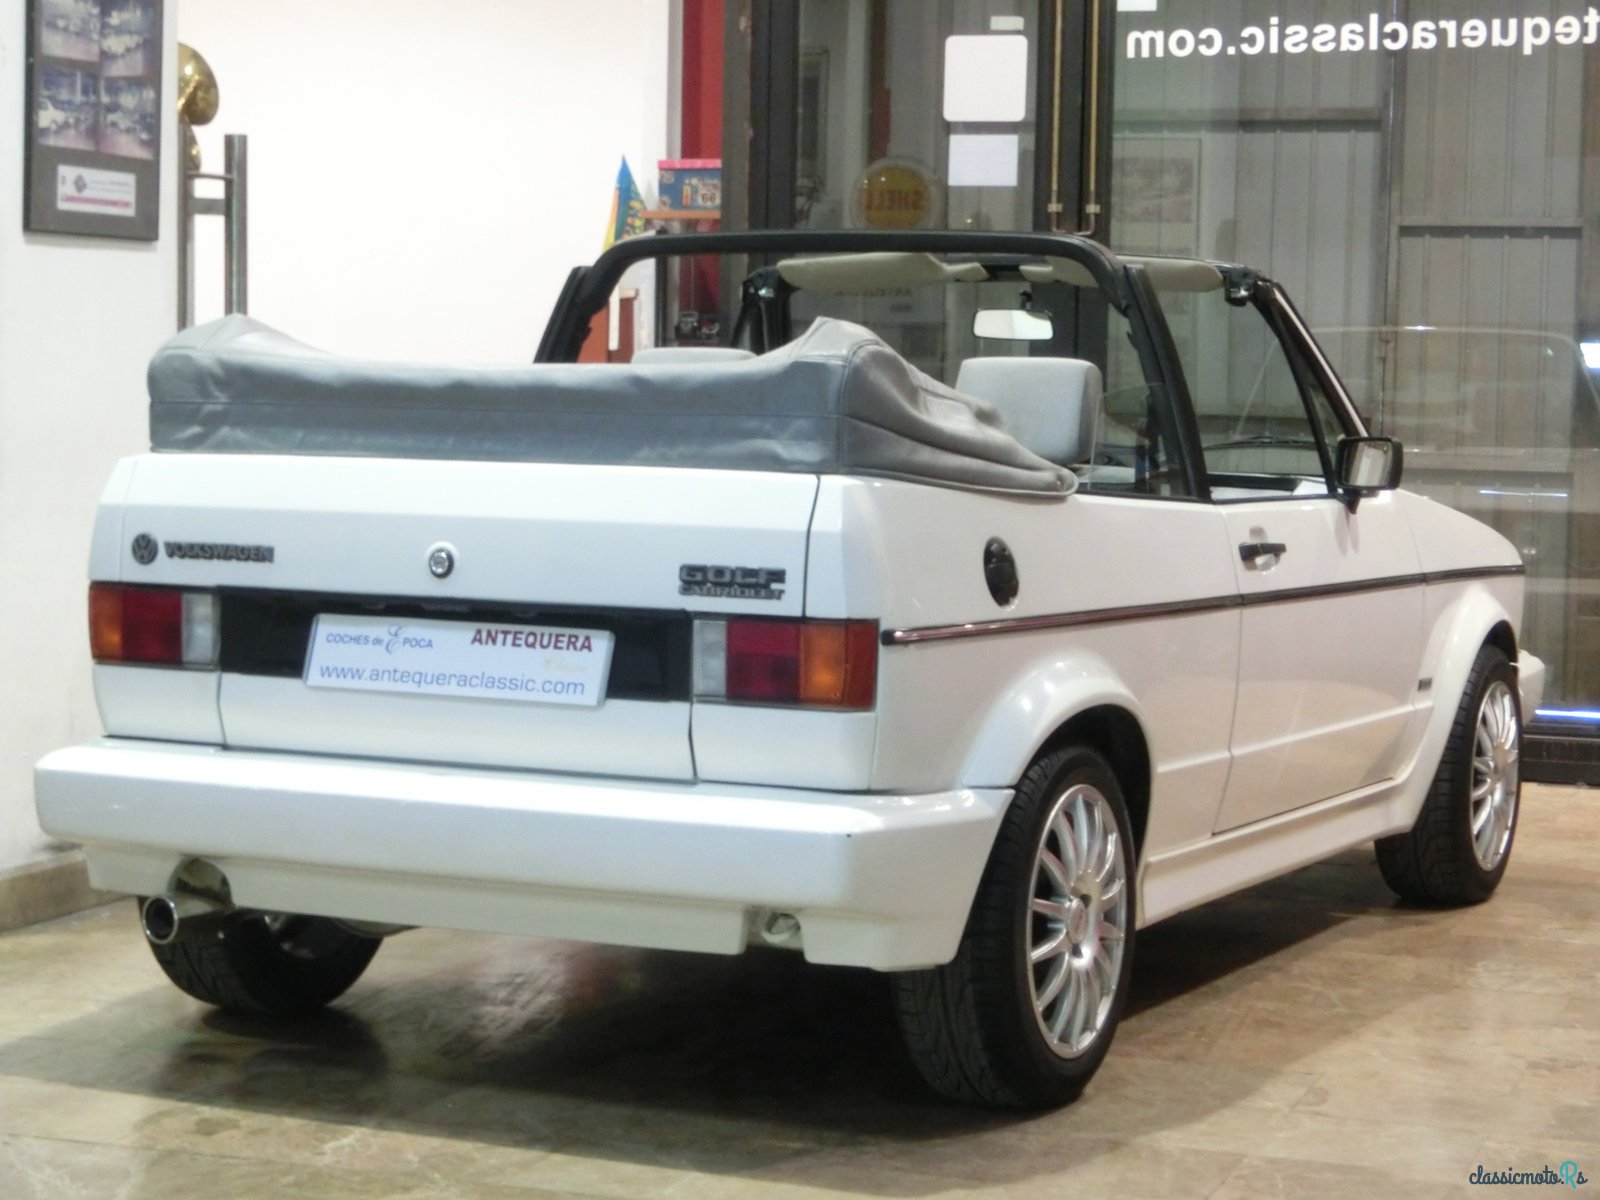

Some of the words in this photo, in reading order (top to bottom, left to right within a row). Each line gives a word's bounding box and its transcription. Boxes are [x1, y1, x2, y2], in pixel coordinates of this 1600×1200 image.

[164, 541, 275, 563] VOLKSWAGEN
[679, 564, 786, 586] GOLF
[326, 632, 370, 646] COCHES
[471, 628, 593, 652] ANTEQUERA
[319, 666, 586, 696] www.antequeraclassic.com
